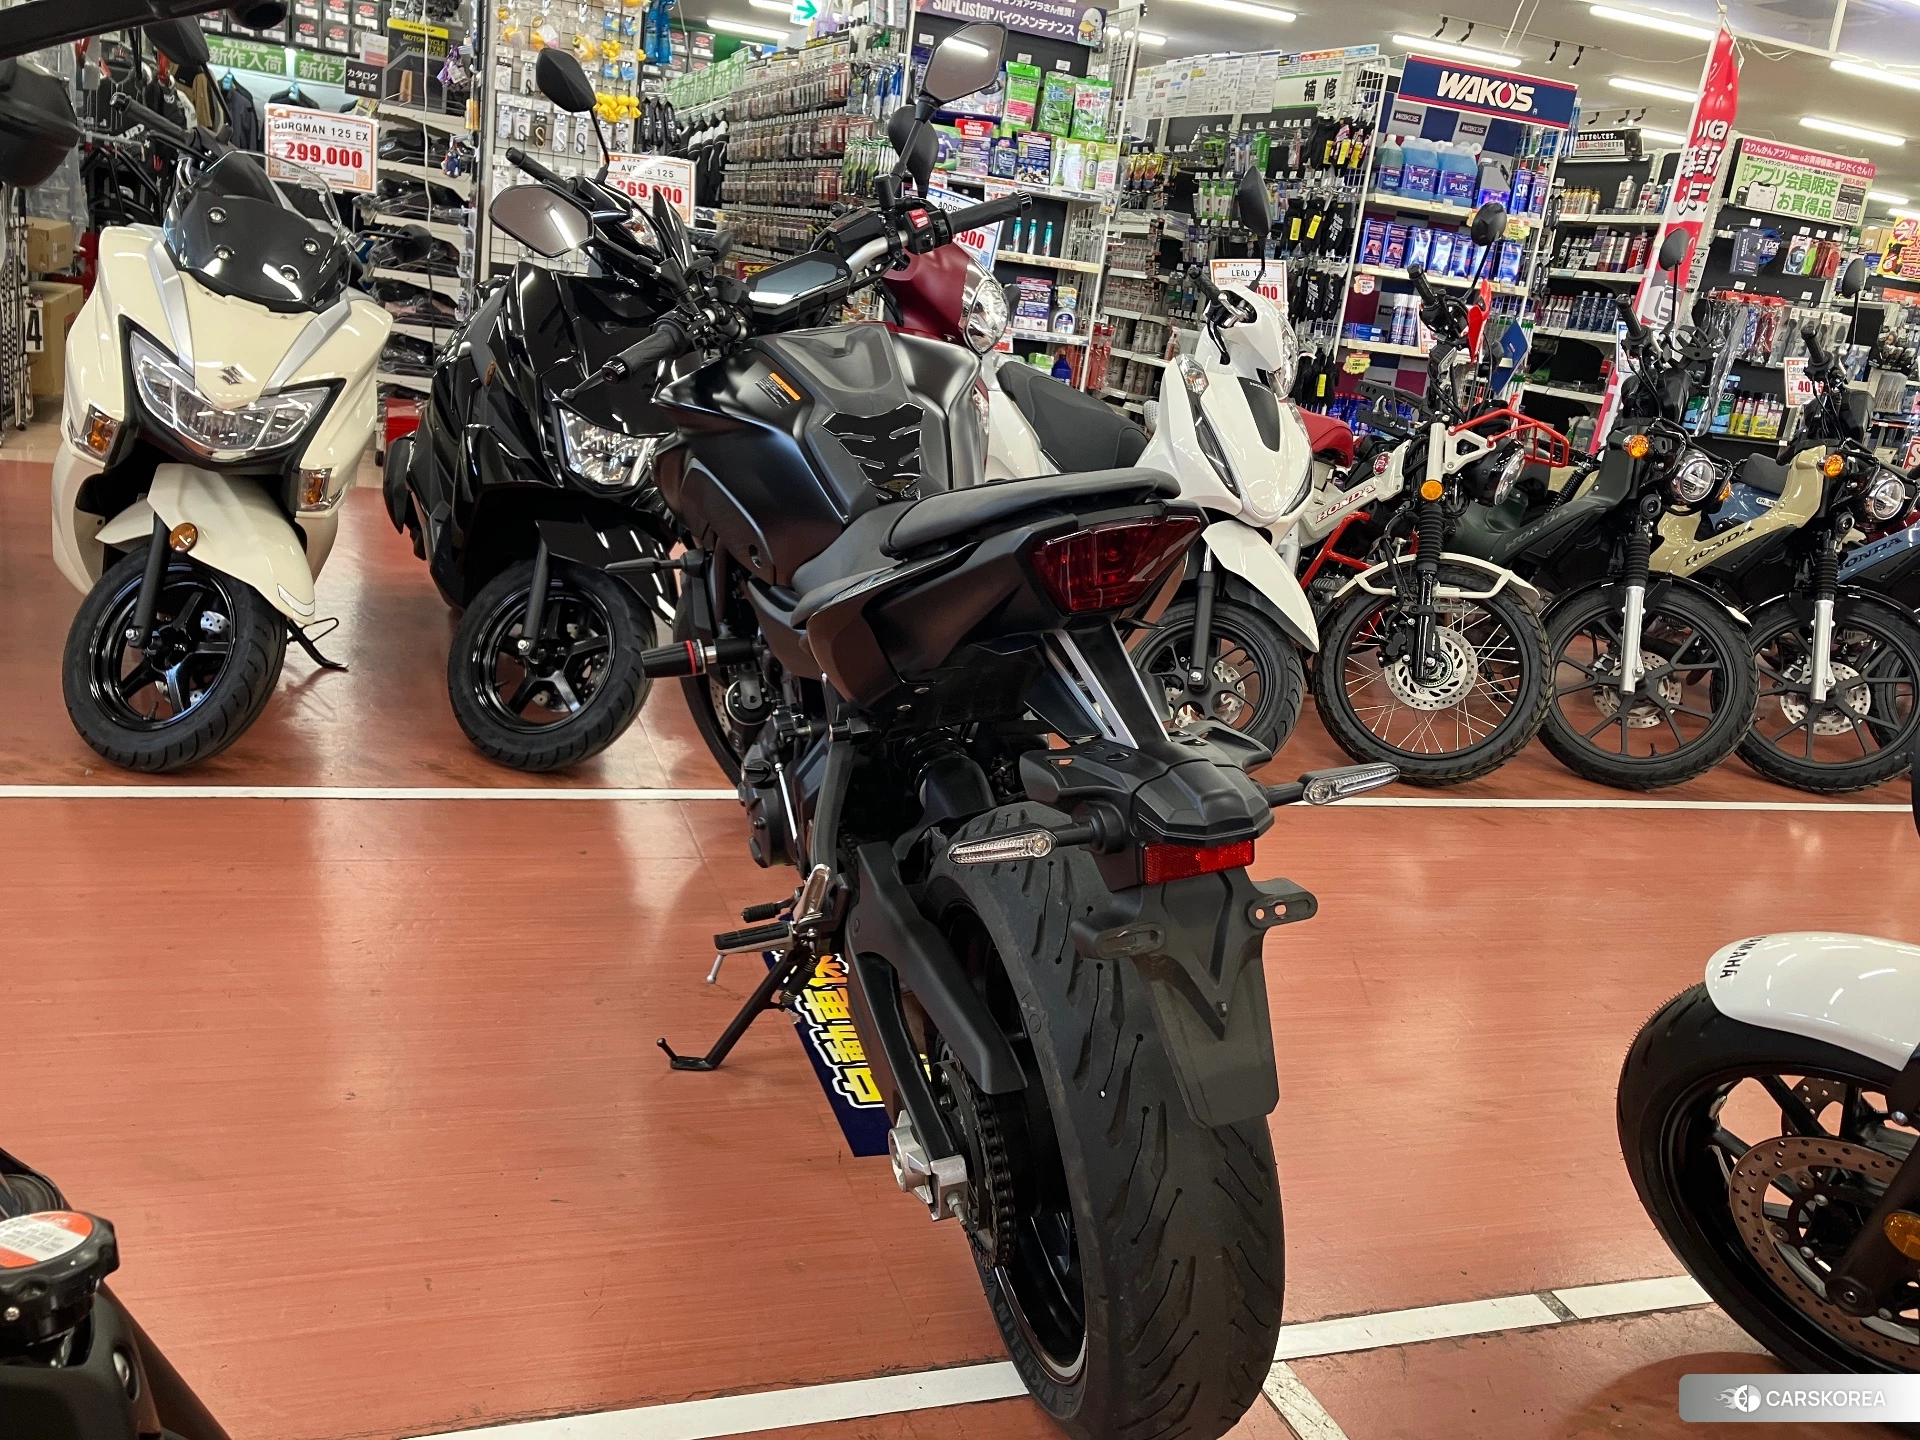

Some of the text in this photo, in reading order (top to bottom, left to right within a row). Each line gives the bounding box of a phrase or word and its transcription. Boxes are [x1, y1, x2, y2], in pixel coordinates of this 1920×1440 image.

[994, 10, 1076, 37] バイクメンテナンス
[402, 33, 447, 47] MOTORYCLE
[208, 46, 283, 73] 新作入荷
[347, 68, 379, 81] カタログ
[1303, 78, 1338, 102] 補修
[1436, 70, 1535, 112] WAKO'S
[273, 121, 326, 135] BURGMAN
[331, 127, 351, 138] 125
[355, 131, 369, 142] EX
[285, 141, 363, 169] 299,000
[621, 164, 674, 178] AVEIS 125
[1749, 164, 1839, 198] アプリ会員限定
[617, 180, 682, 205] 269,00
[1449, 183, 1469, 192] PLUS
[1776, 192, 1833, 219] お買得品
[1764, 240, 1780, 249] LOCK
[1231, 269, 1267, 278] LEAD 15
[26, 309, 43, 350] 4
[1315, 484, 1376, 524] HONDA
[1504, 510, 1570, 551] HONDA
[1684, 524, 1755, 567] HONDA
